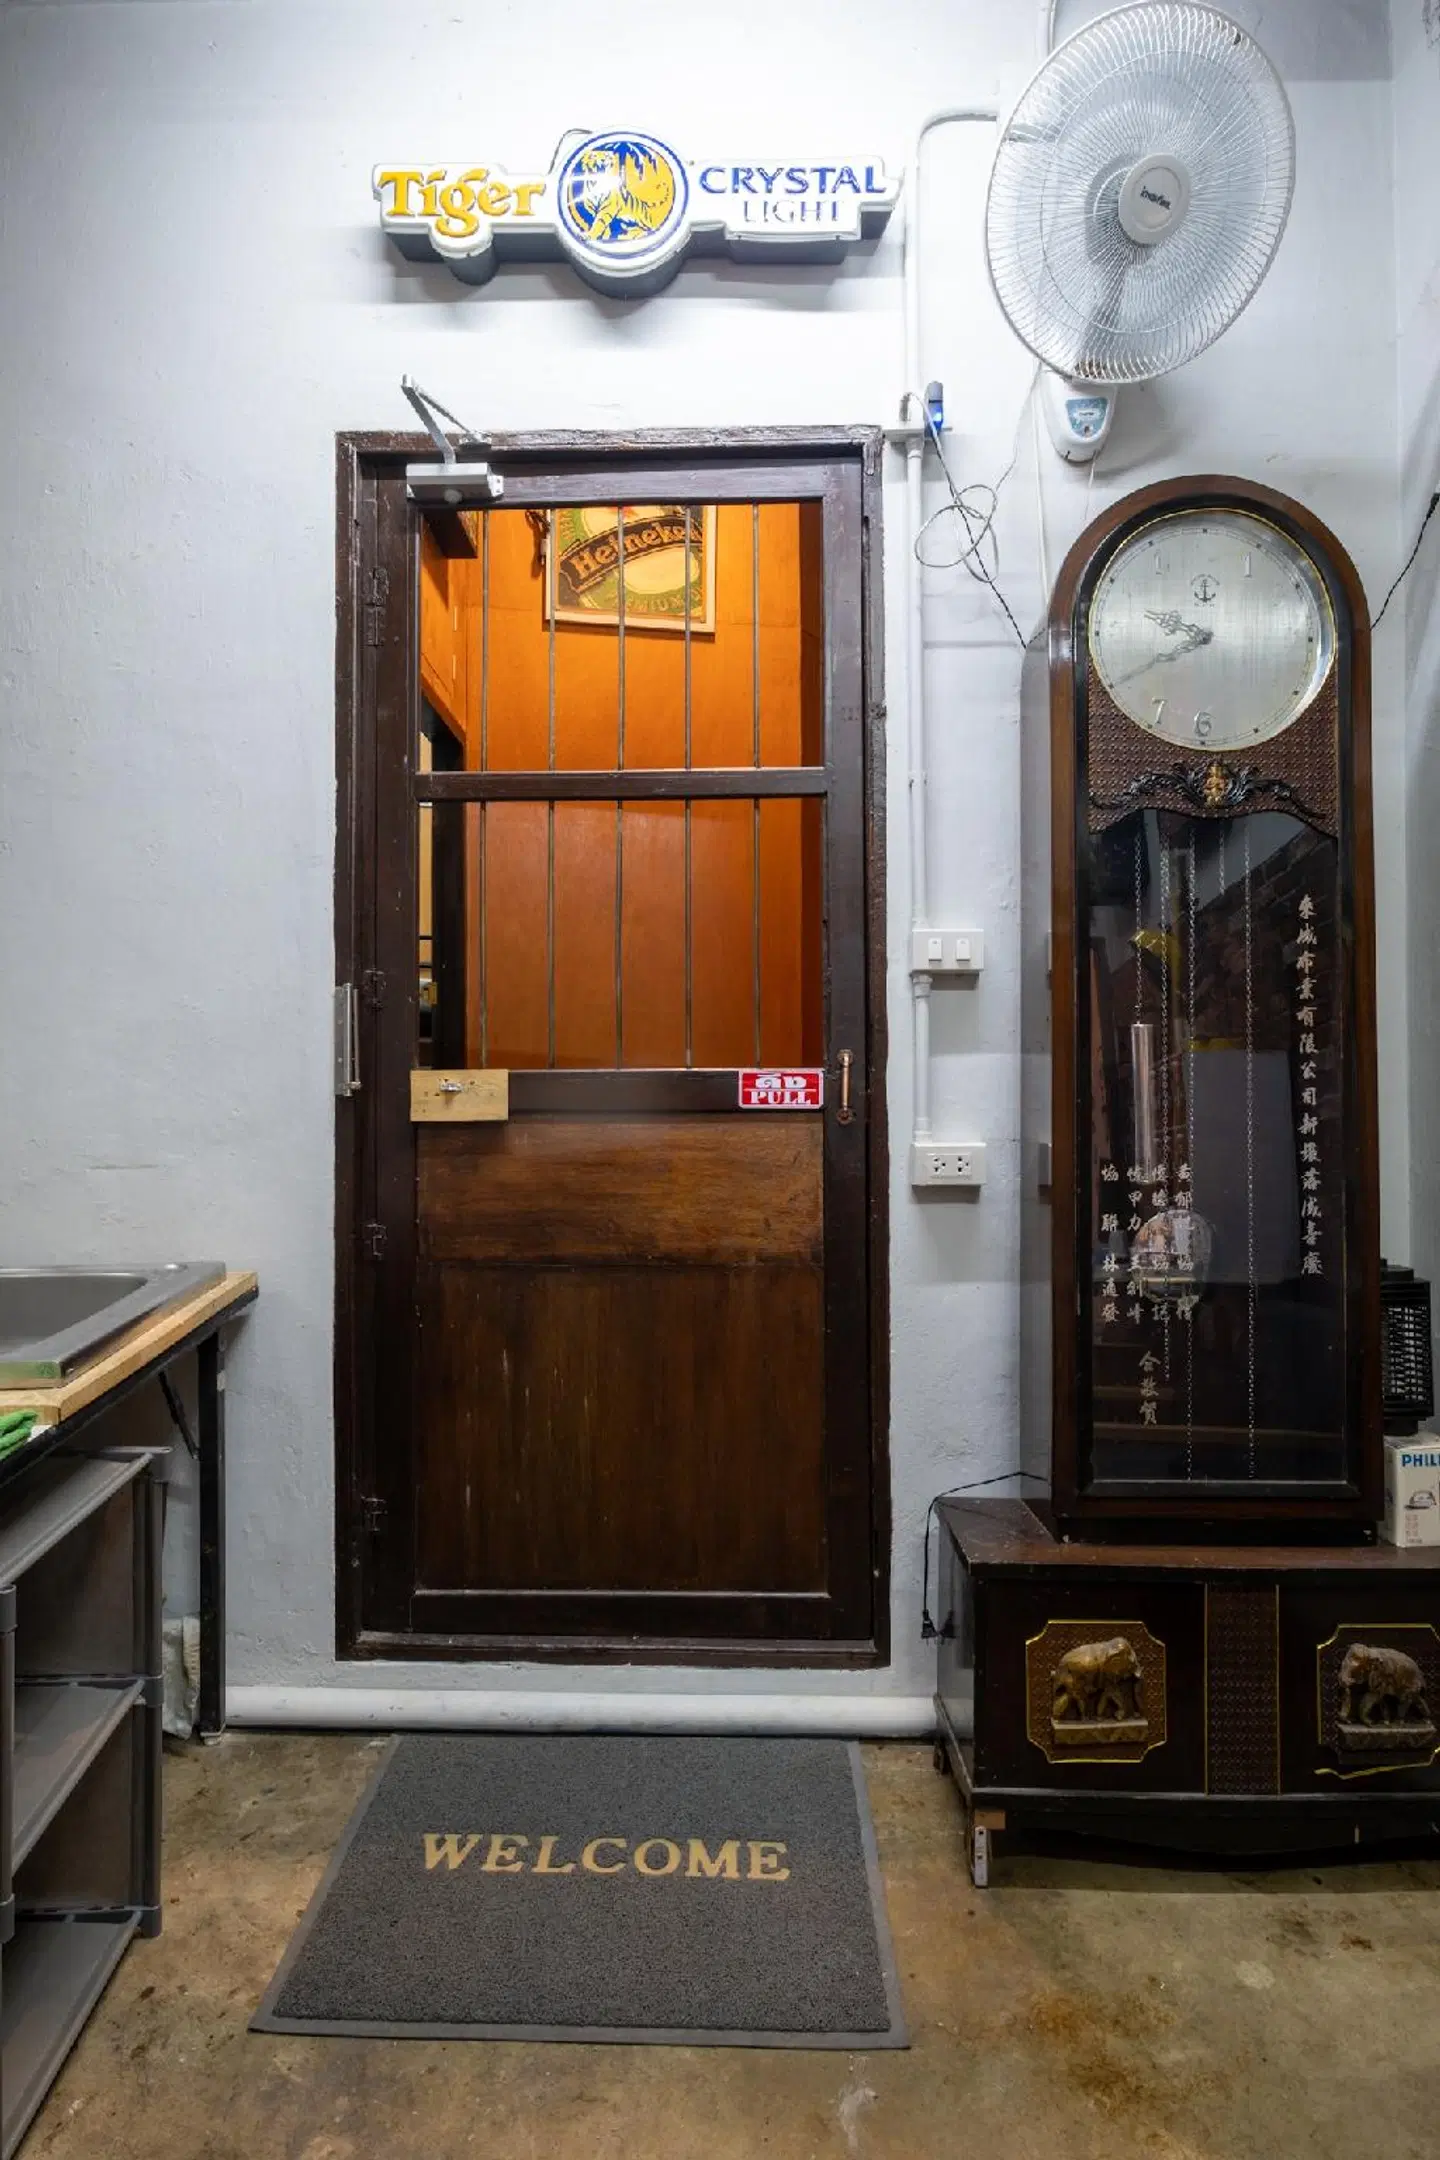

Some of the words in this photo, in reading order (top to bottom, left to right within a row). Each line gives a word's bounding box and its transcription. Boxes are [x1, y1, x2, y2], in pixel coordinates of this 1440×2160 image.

[699, 166, 886, 194] CRYSTAL
[377, 168, 546, 239] Tiger
[744, 200, 842, 223] LIGHT
[750, 1091, 812, 1105] PULL
[422, 1831, 792, 1882] WELCOME
